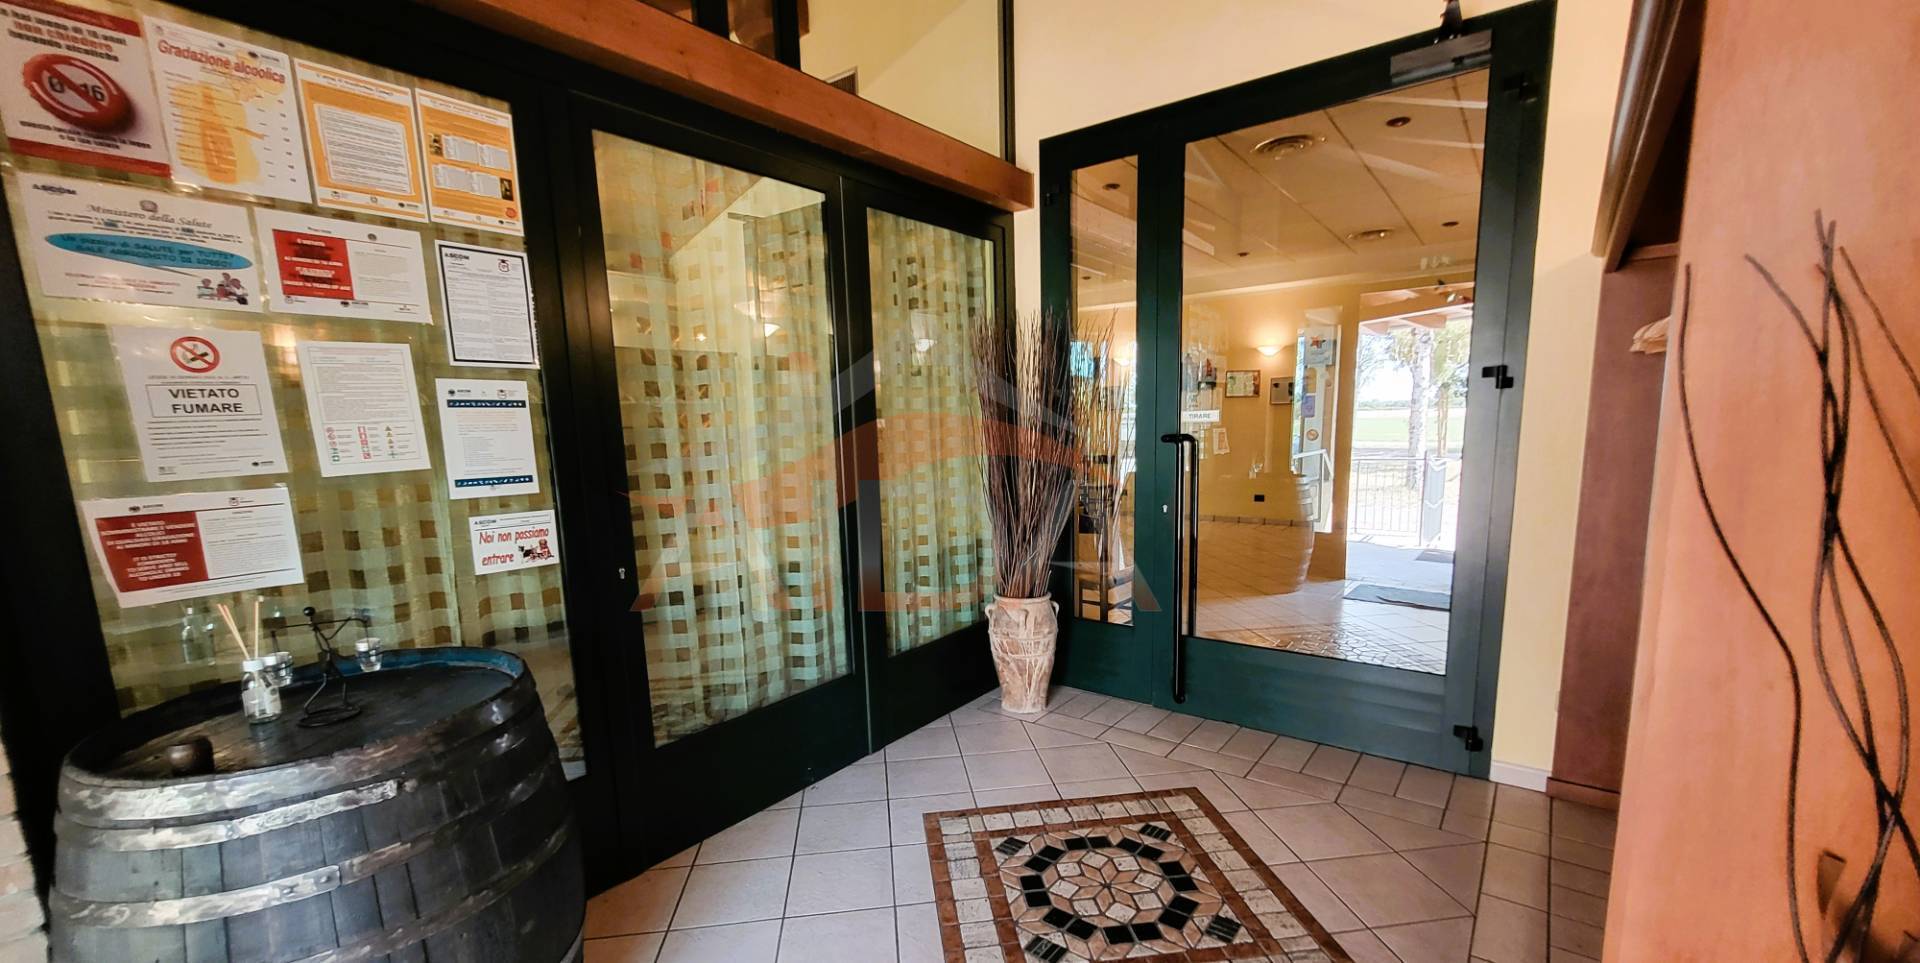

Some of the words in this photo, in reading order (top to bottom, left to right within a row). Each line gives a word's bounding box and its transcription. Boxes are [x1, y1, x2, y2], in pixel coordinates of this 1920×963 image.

[157, 39, 232, 69] Gradazione
[233, 60, 286, 84] alcoolica
[87, 203, 146, 219] Ministero
[148, 213, 176, 224] della
[177, 216, 214, 229] Salute
[168, 388, 240, 399] VIETATO
[171, 402, 244, 414] FUMARE
[479, 531, 494, 545] Noi
[497, 531, 512, 543] non
[514, 526, 550, 545] passiamo
[481, 553, 515, 566] entrare
